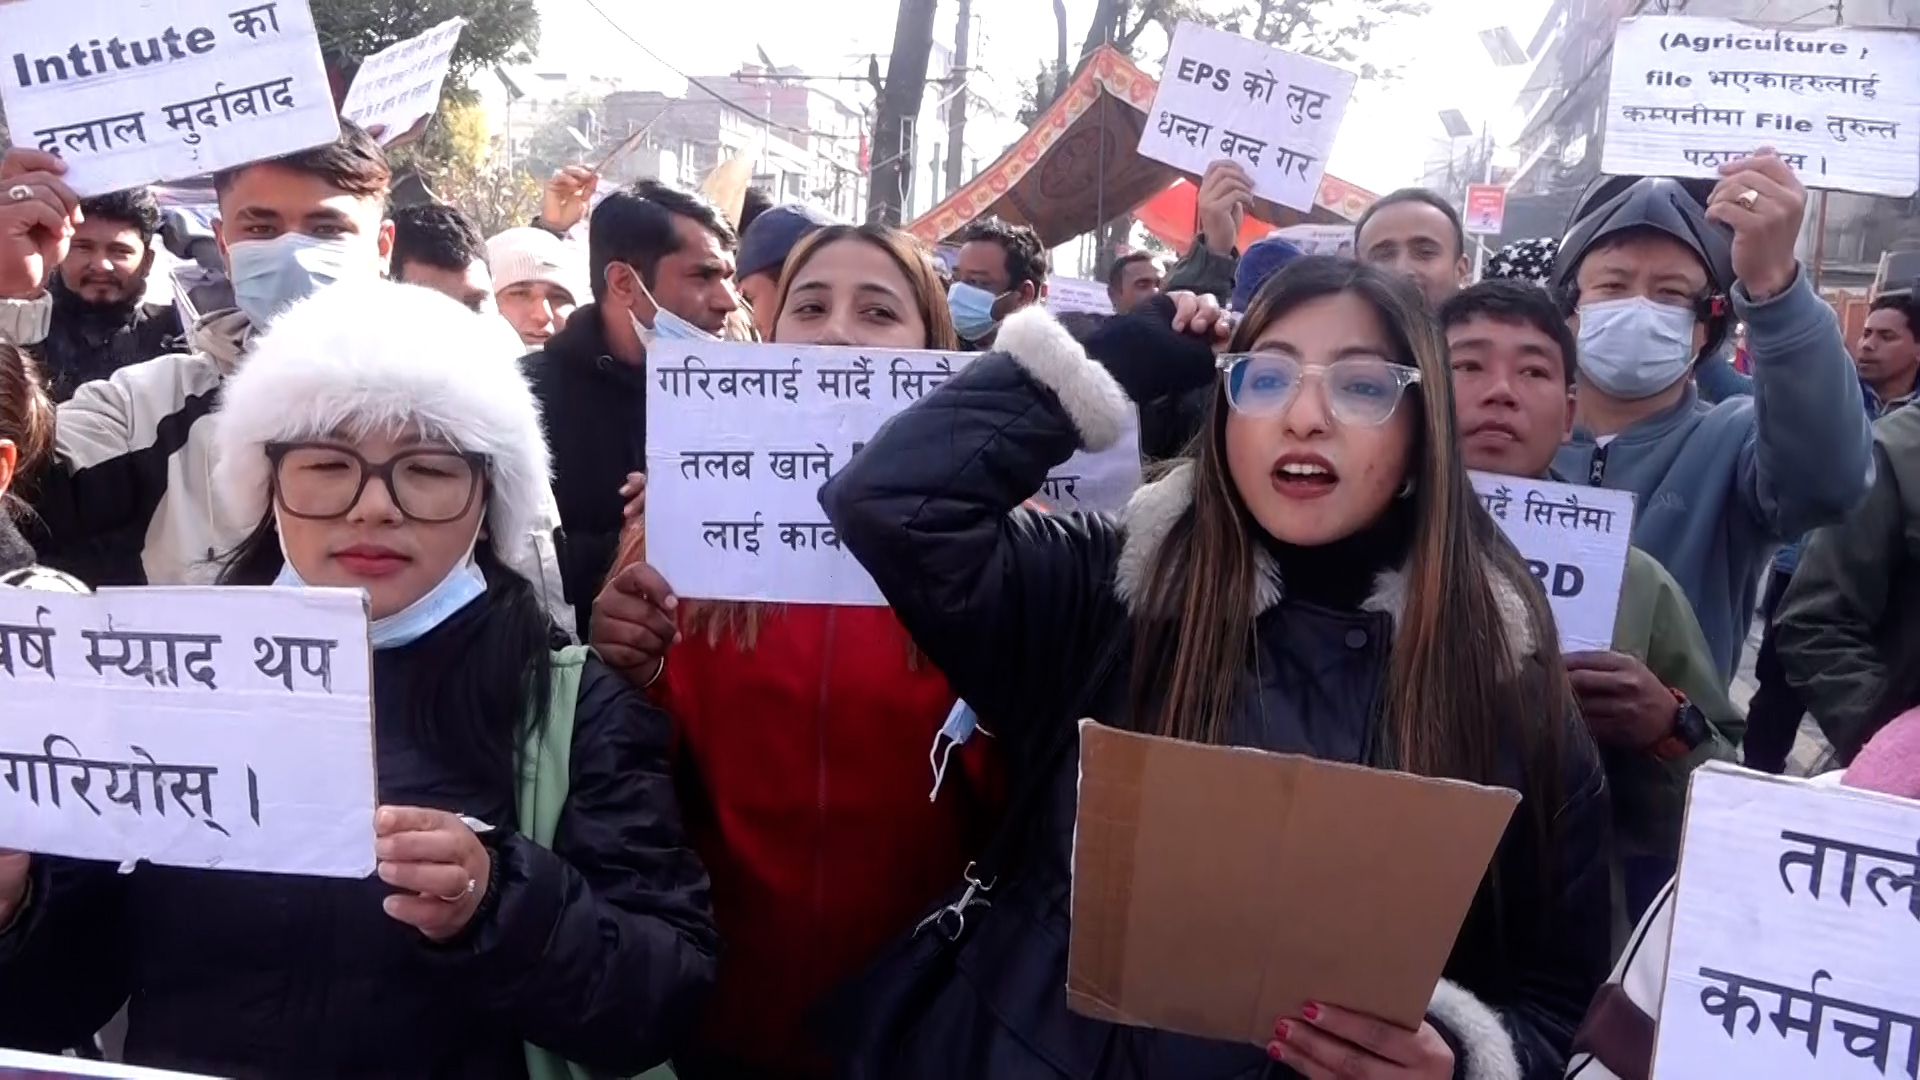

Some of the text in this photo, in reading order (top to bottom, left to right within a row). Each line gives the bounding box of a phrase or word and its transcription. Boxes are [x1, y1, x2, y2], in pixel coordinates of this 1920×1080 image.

[13, 3, 281, 87] Intitute का
[1659, 32, 1848, 55] (Agriculture
[1177, 56, 1331, 124] EPS को लुट
[1646, 69, 1693, 88] file
[34, 76, 295, 158] दलाल मुर्दाबाद
[1622, 103, 1745, 127] कम्पनीमा
[1756, 113, 1813, 132] File
[1158, 110, 1318, 182] धन्दा बन्द गर
[657, 355, 803, 403] गरिबलाई
[817, 356, 875, 400] मार्दै
[680, 450, 754, 480] तलब
[768, 442, 834, 480] खाने
[702, 512, 764, 554] लाई
[1526, 558, 1585, 598] RD
[253, 634, 339, 693] थप
[1778, 828, 1920, 922] ताल
[1699, 968, 1920, 1080] कर्मचा
